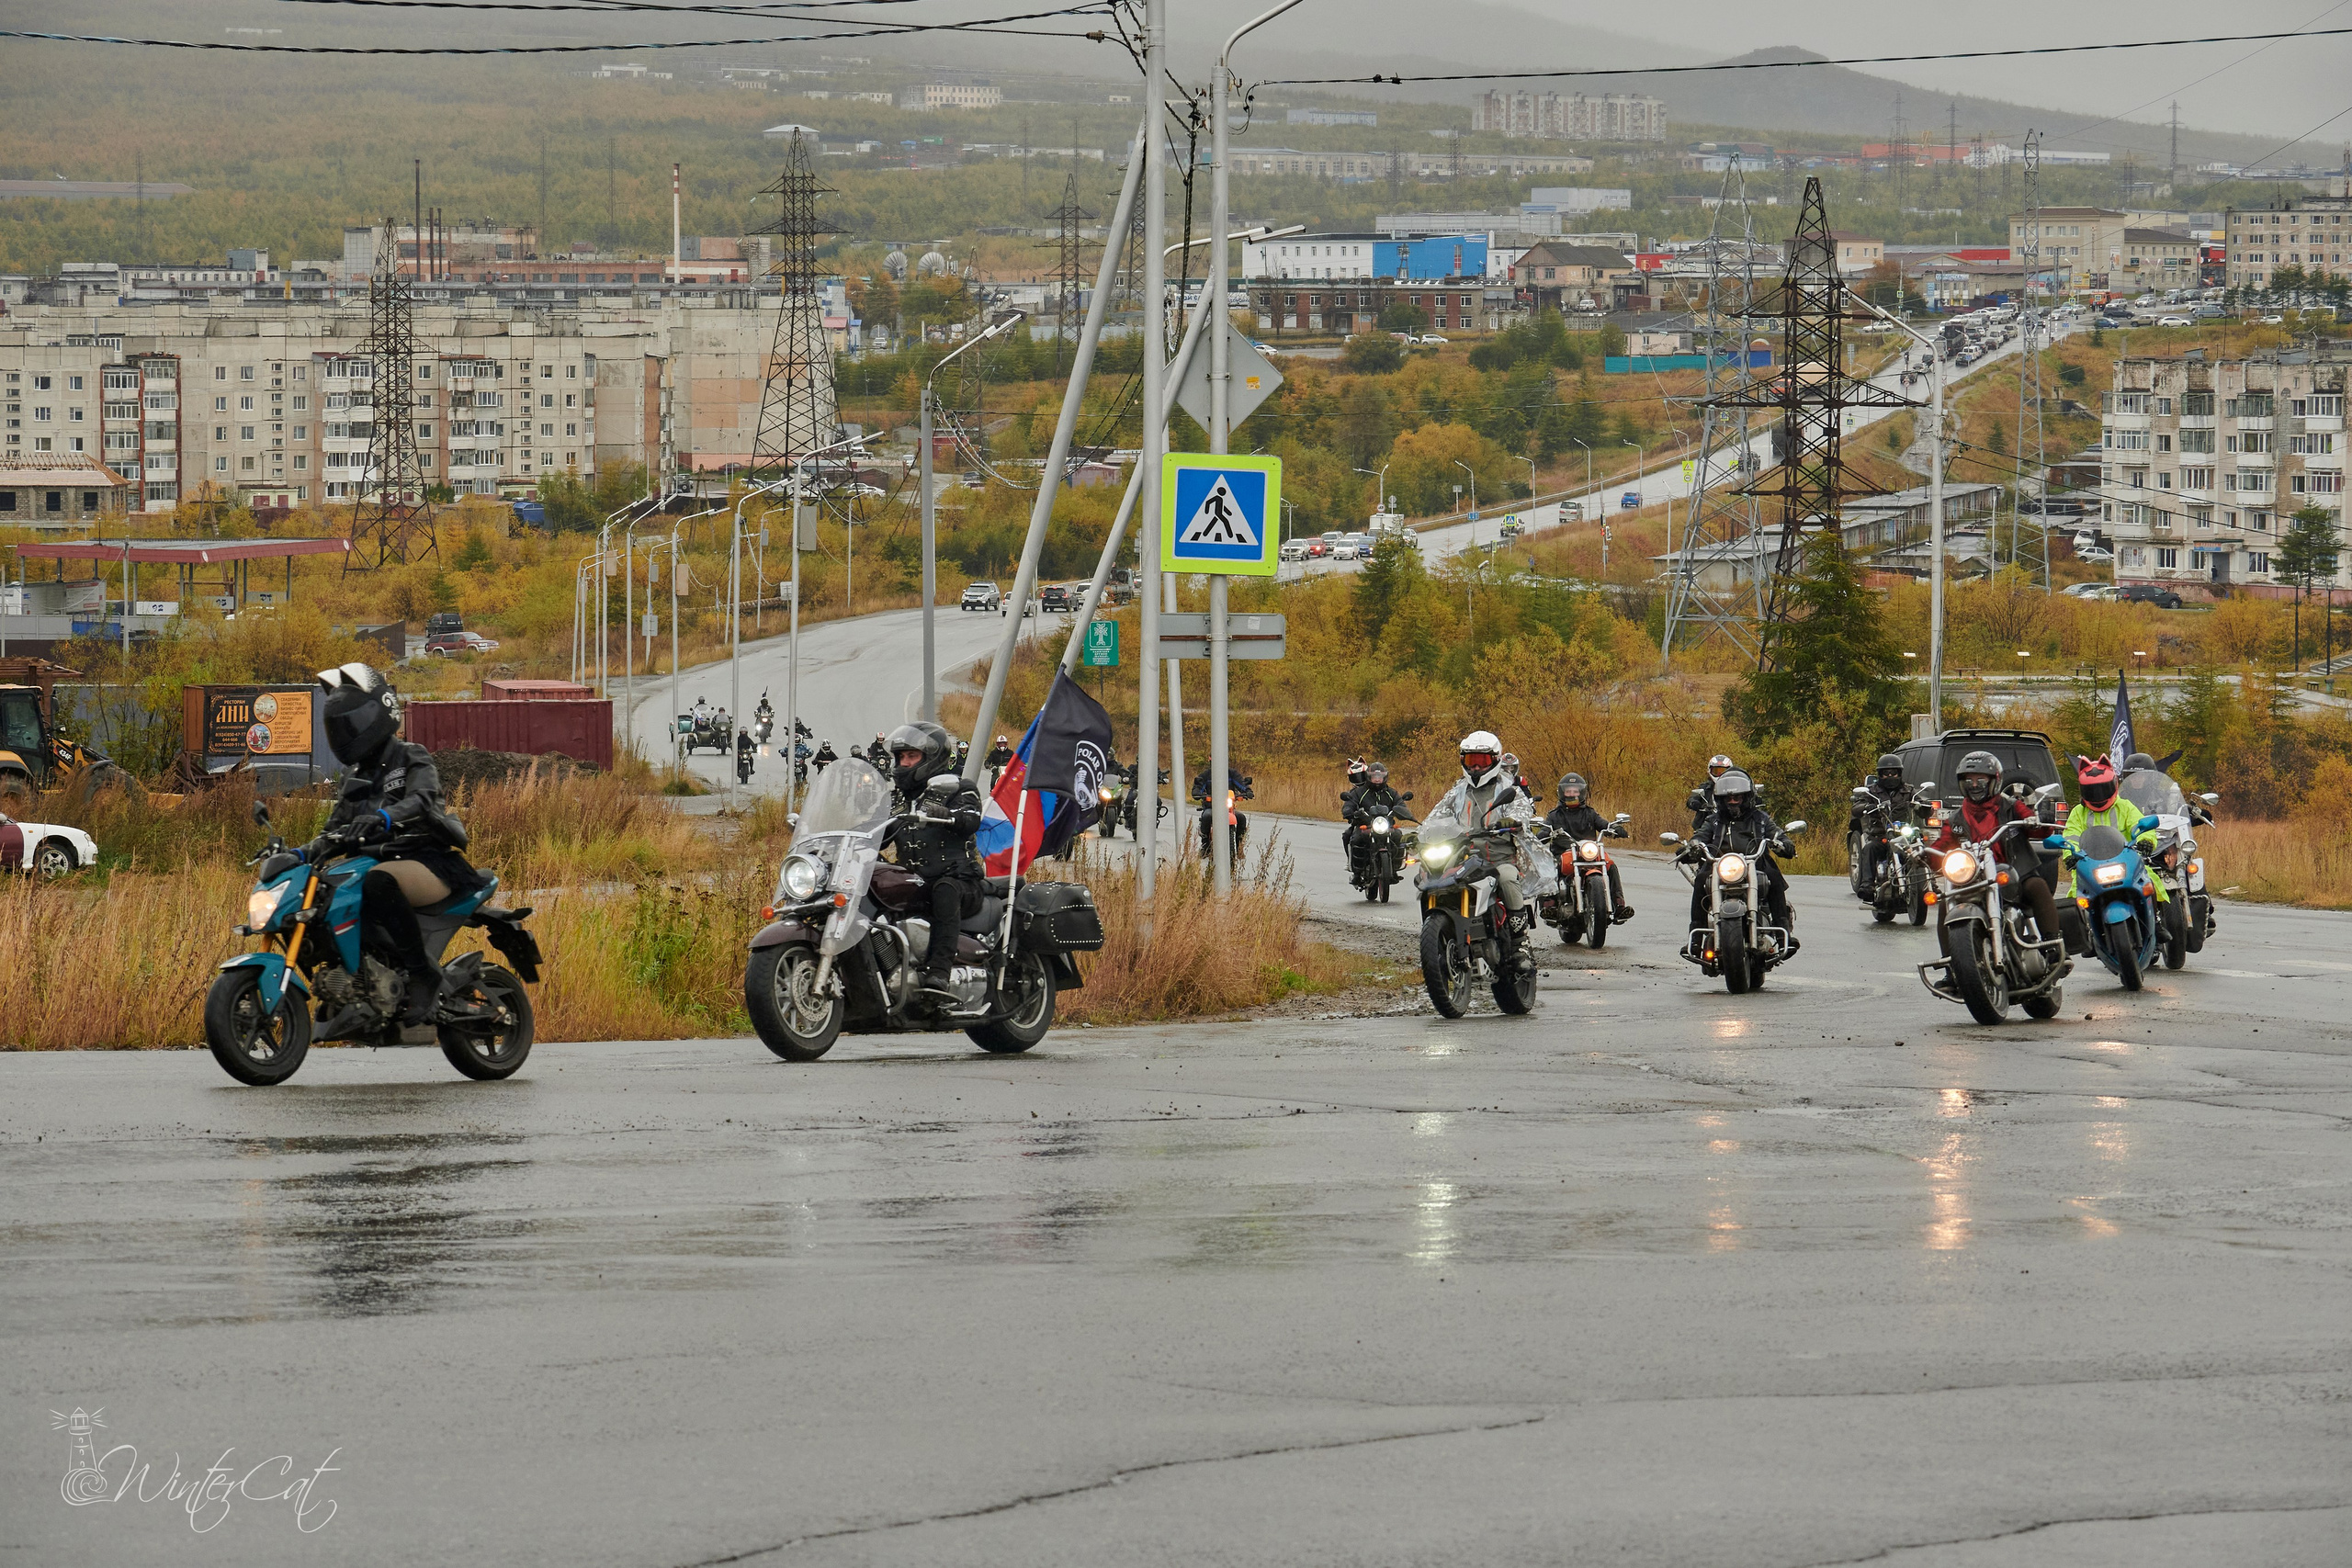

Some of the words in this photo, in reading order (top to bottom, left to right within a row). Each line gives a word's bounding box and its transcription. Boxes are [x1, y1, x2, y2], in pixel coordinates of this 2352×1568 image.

[152, 604, 164, 612] 92
[216, 705, 249, 723] АНИ
[1078, 748, 1101, 770] POLAR
